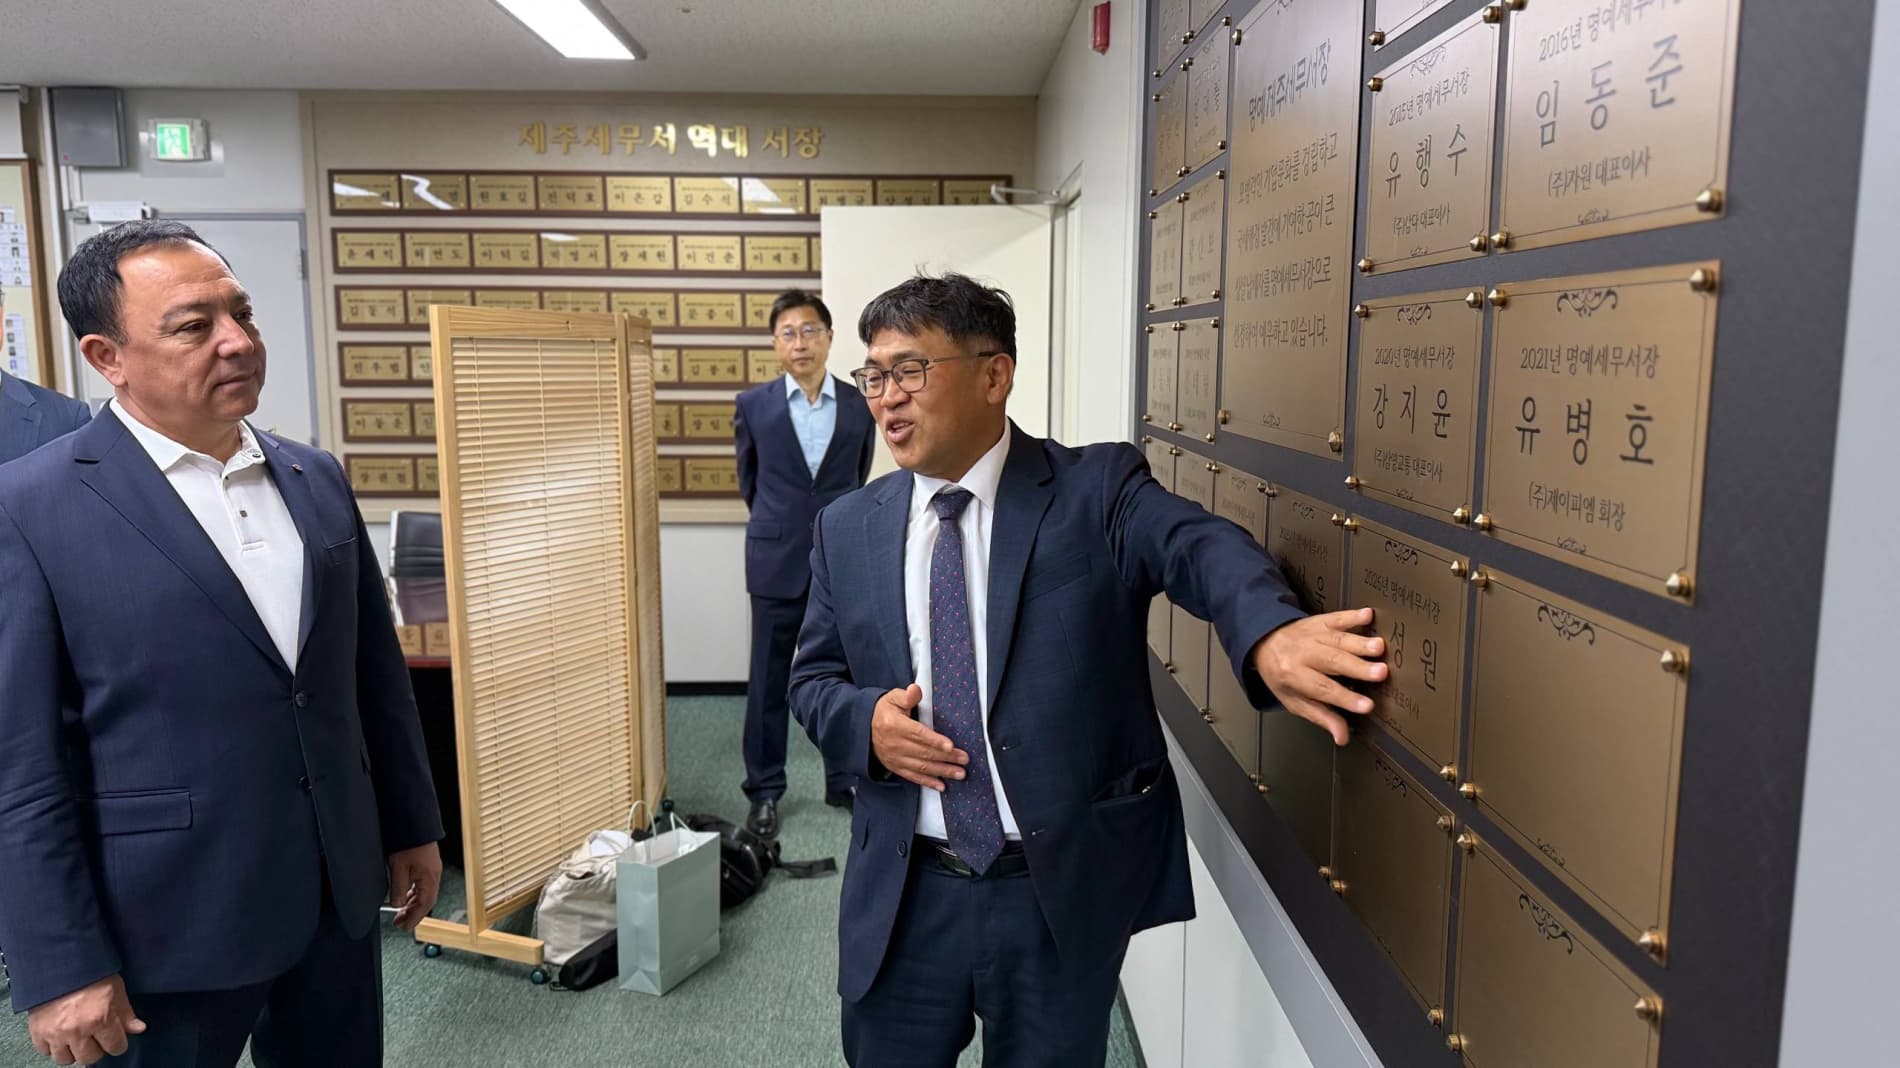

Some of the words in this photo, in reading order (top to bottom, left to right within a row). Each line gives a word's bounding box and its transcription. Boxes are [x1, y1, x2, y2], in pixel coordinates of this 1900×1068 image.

[1539, 17, 1582, 62] 2016년
[1388, 102, 1415, 127] 2015년
[1415, 67, 1471, 118] 명예세무서장
[517, 120, 677, 157] 제주세무서
[687, 123, 750, 159] 역대
[761, 127, 824, 160] 서장
[1547, 163, 1593, 199] (주)자원
[1594, 145, 1653, 192] 대표이사
[1420, 205, 1450, 231] 대표이사
[1290, 313, 1329, 347] 있습니다.
[1402, 343, 1456, 370] 명예세무서장
[1520, 346, 1562, 375] 2021년
[1565, 344, 1660, 380] 명예세무서장
[1413, 459, 1443, 483] 대표이사
[1528, 481, 1597, 523] (주)제이피엠
[1598, 497, 1626, 533] 회장
[1390, 581, 1441, 625] 명예세무서장
